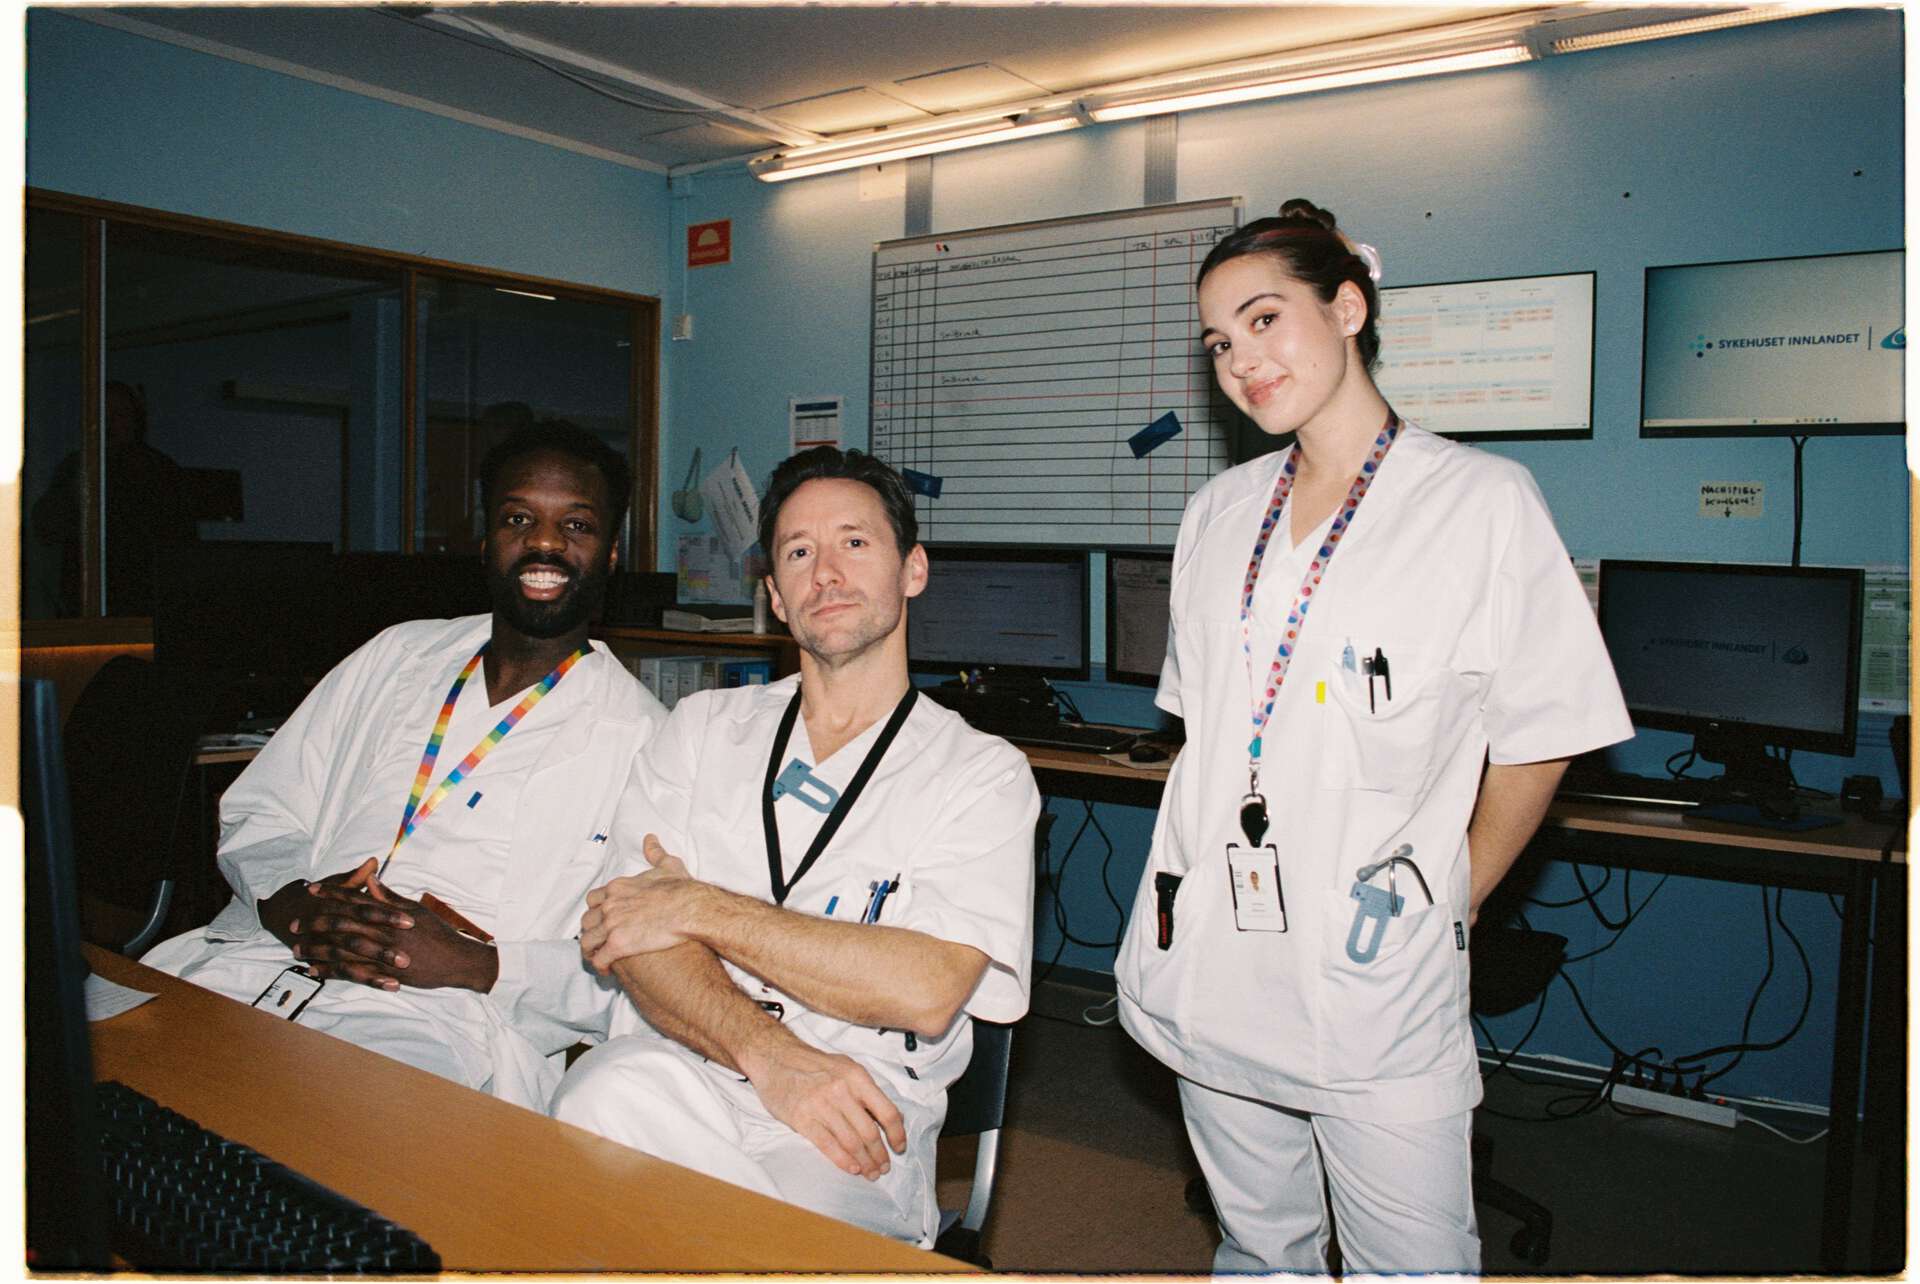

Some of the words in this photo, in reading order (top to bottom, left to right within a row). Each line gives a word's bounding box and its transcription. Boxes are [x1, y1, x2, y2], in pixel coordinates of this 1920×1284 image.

[1719, 337, 1785, 349] SYKEHUSET
[1788, 333, 1860, 346] INNLANDET
[1712, 641, 1768, 653] INNLANDET
